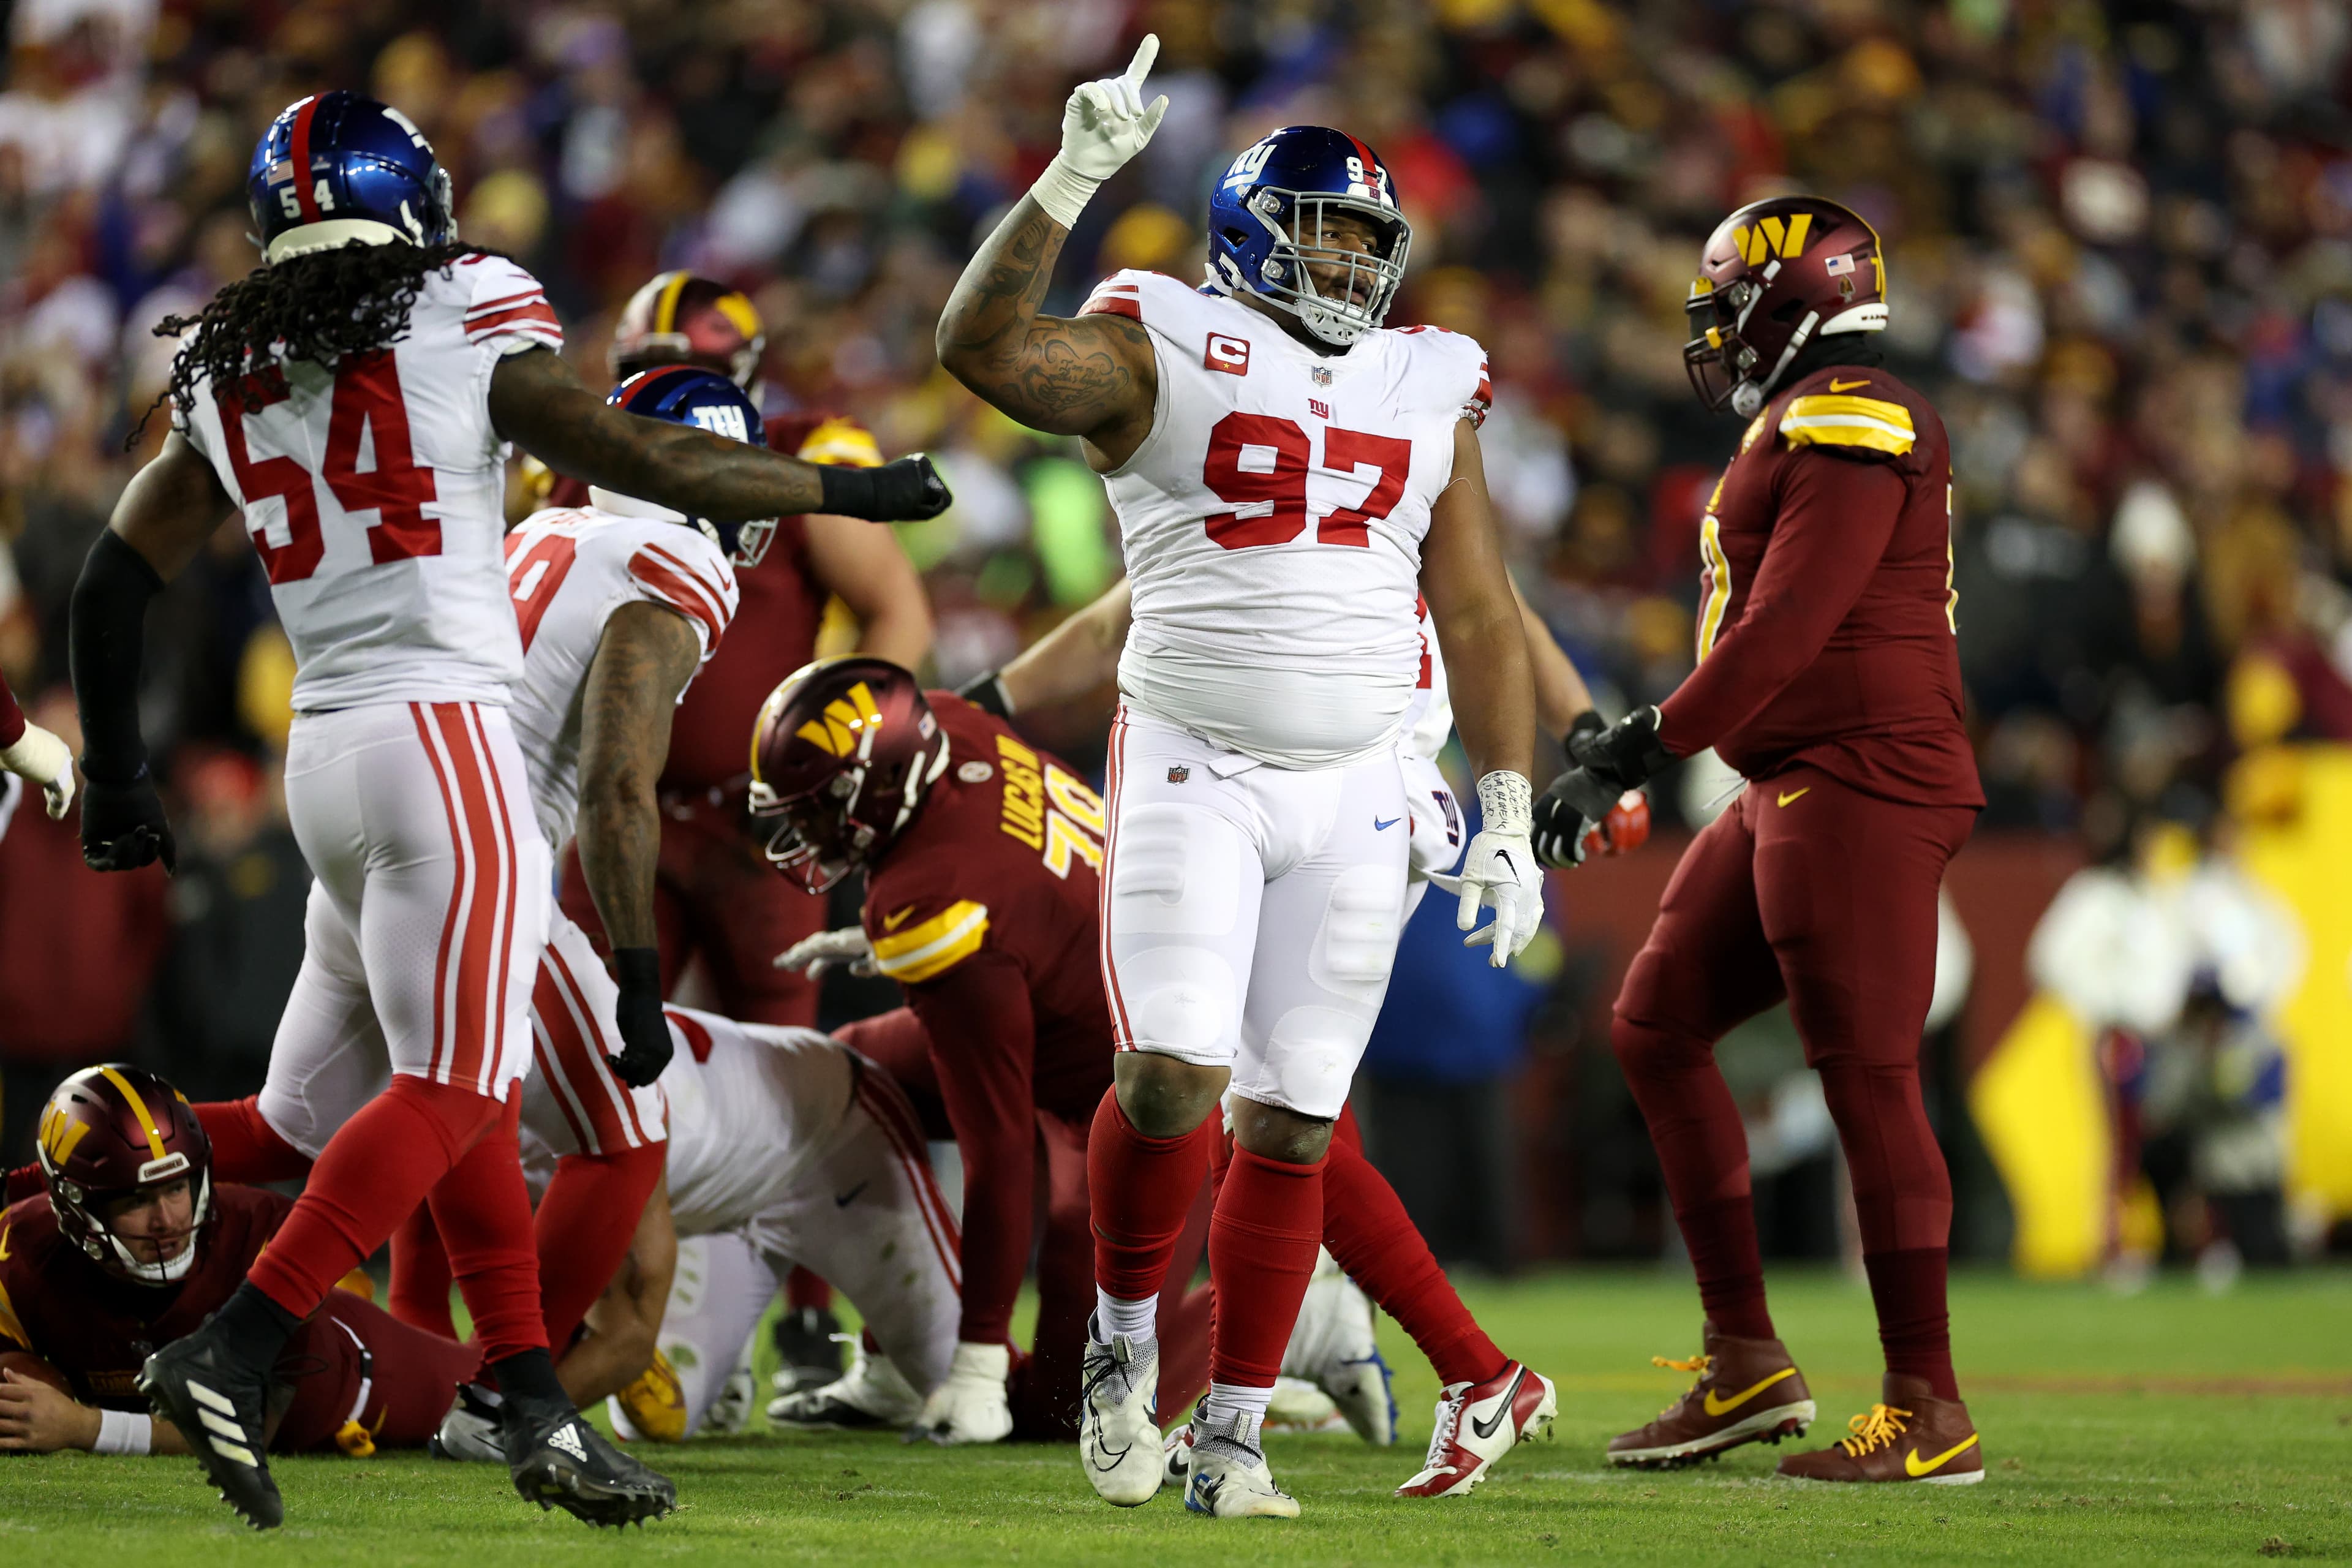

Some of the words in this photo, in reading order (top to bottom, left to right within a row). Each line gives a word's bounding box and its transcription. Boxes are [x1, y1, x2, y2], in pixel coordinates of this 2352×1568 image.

[1346, 156, 1387, 192] 97
[279, 178, 335, 219] 54
[1210, 336, 1247, 366] C
[216, 348, 442, 586] 54
[1204, 411, 1412, 550] 97
